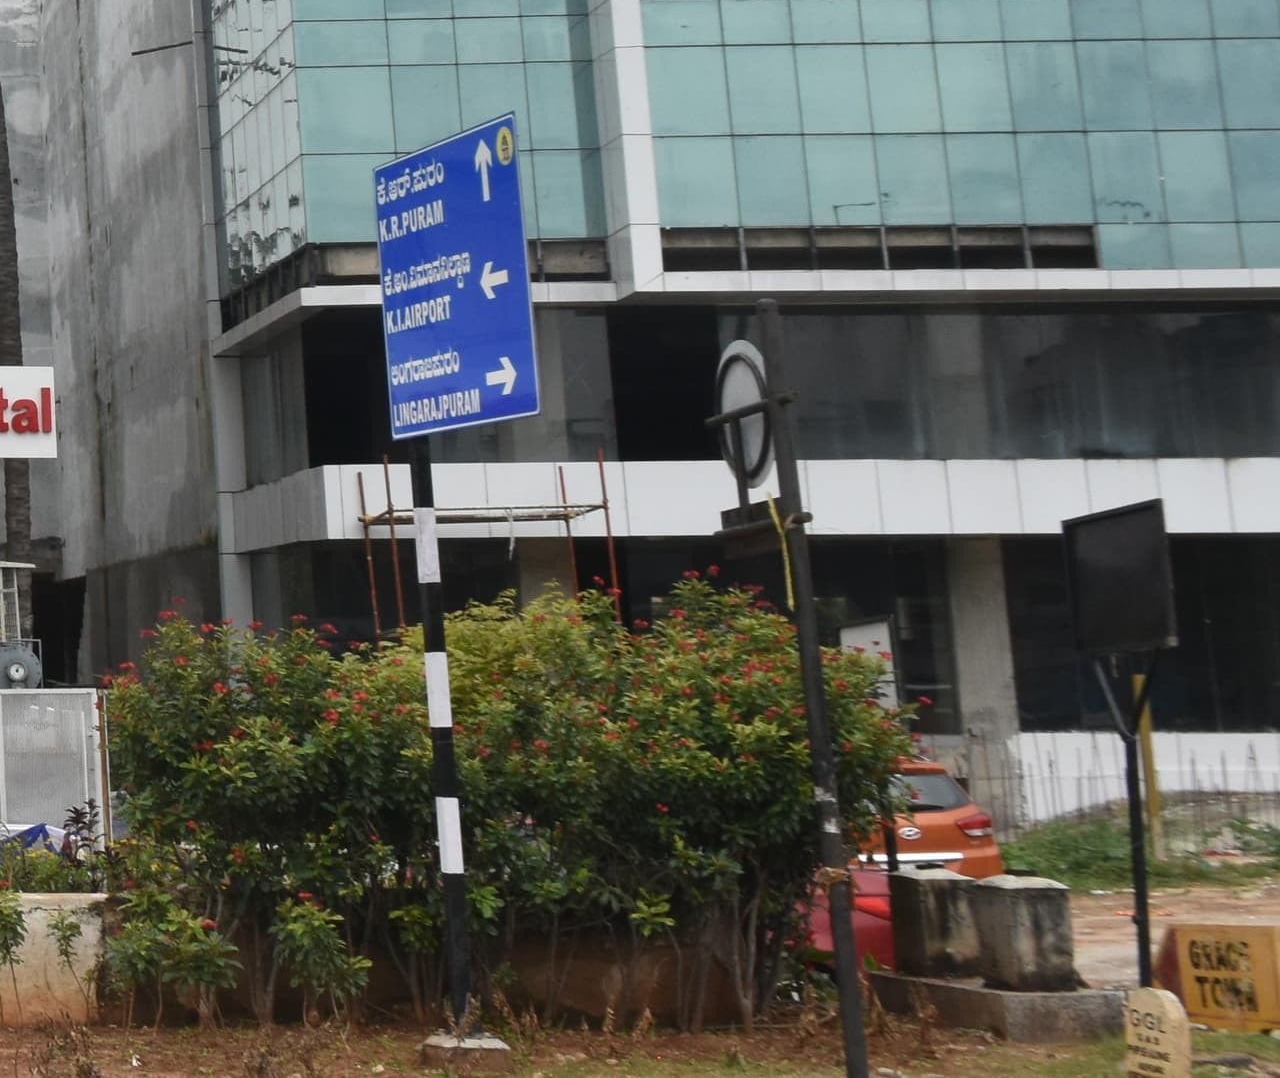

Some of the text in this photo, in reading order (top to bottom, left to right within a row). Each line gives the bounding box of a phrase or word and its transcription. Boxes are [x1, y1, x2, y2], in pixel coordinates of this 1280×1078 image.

[379, 199, 445, 243] K.R.PURAM
[386, 295, 451, 334] K.I.AIRPORT
[393, 388, 481, 427] LINGARAJPURAM
